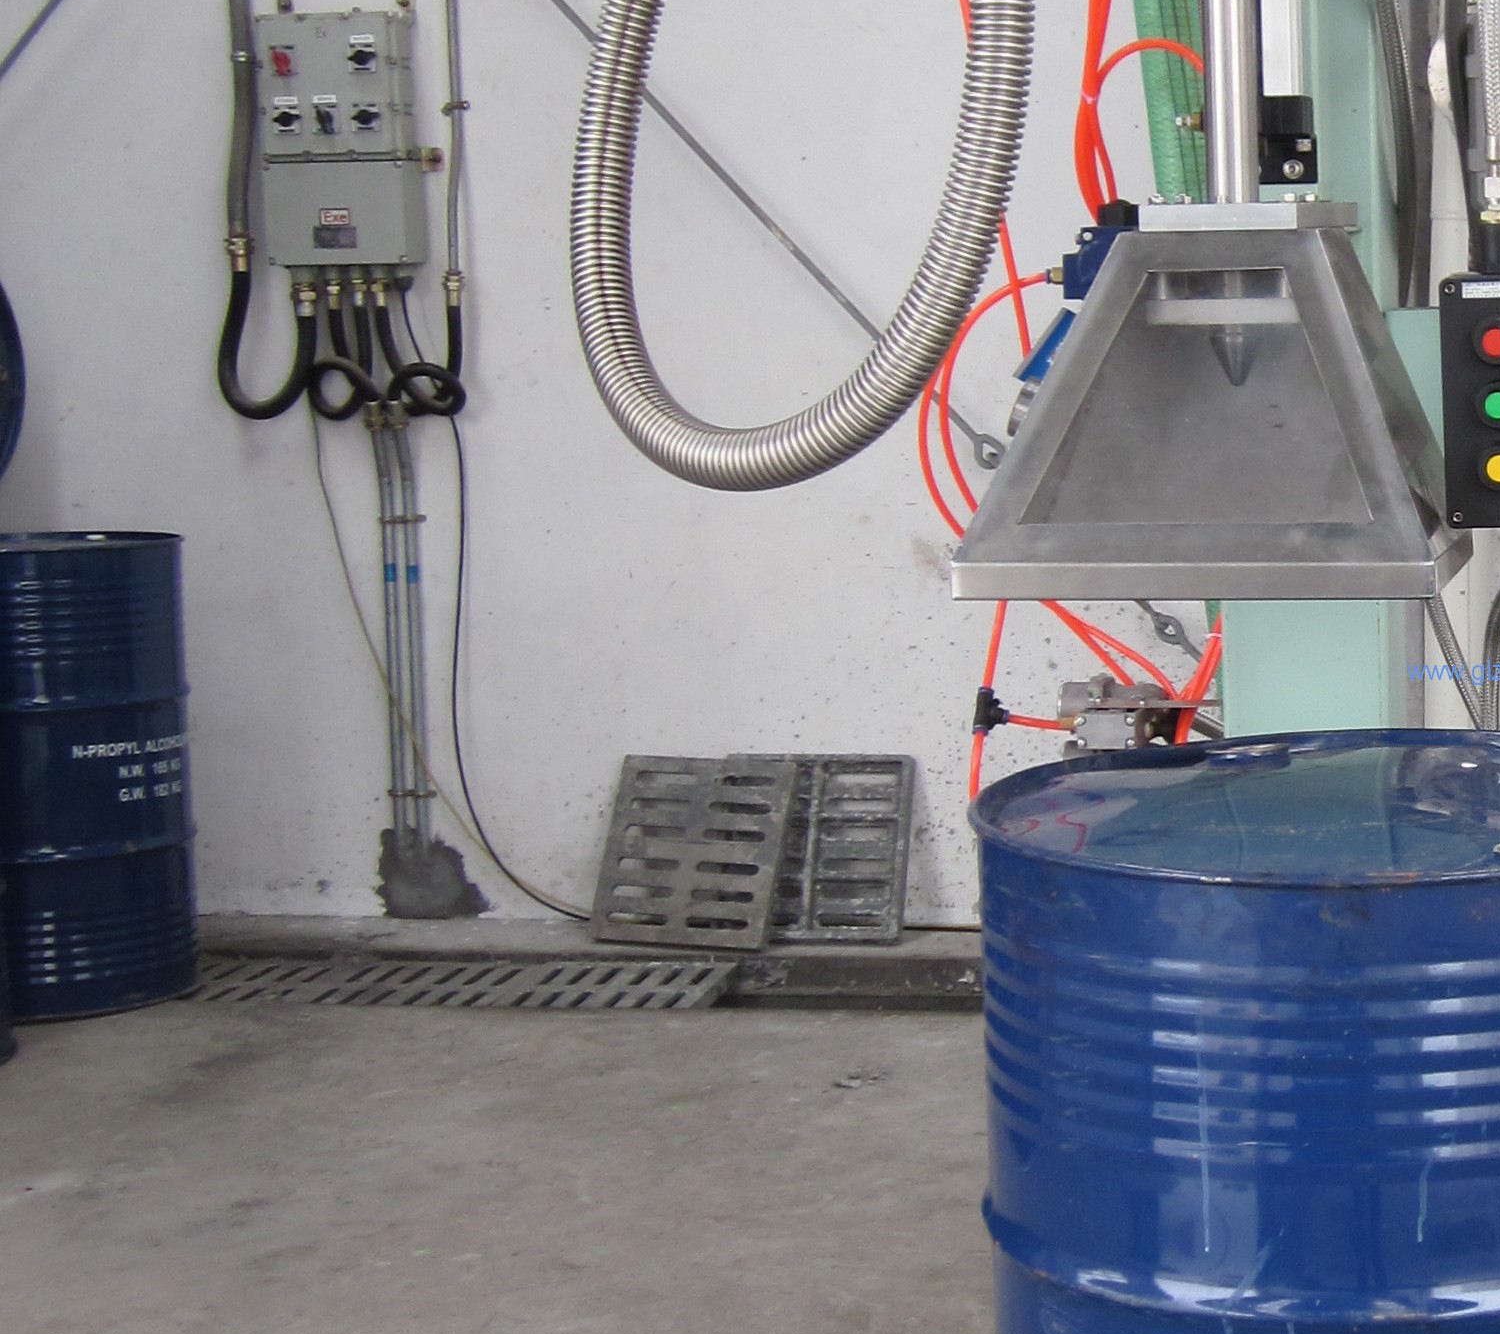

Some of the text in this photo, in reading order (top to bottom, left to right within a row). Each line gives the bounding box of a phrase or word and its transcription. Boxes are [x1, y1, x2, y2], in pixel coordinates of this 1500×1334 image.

[72, 741, 141, 759] N-PROPYL
[118, 763, 145, 779] N.W.
[119, 786, 146, 802] G.W.
